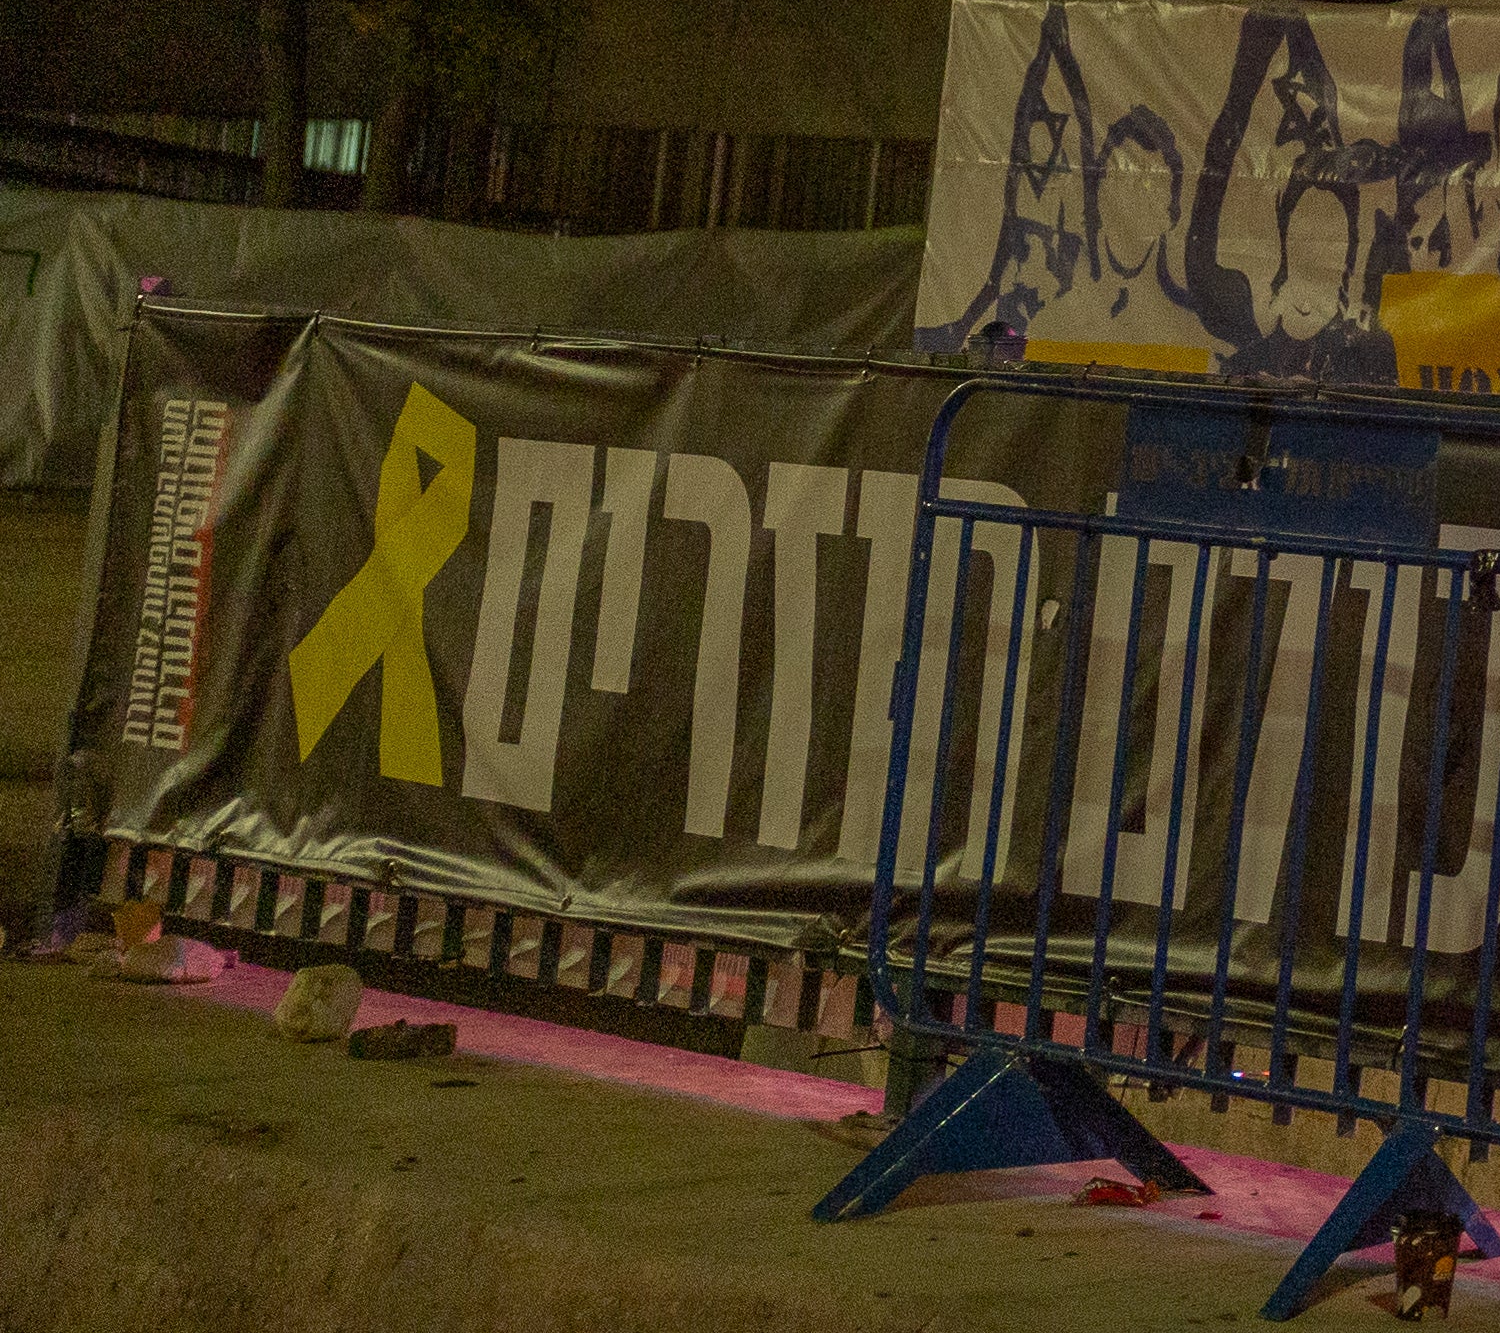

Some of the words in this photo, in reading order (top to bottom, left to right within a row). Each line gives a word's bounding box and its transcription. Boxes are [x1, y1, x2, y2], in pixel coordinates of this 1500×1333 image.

[160, 399, 190, 462] מטה
[170, 399, 228, 567] החטופים
[462, 437, 1041, 885] חוזרים
